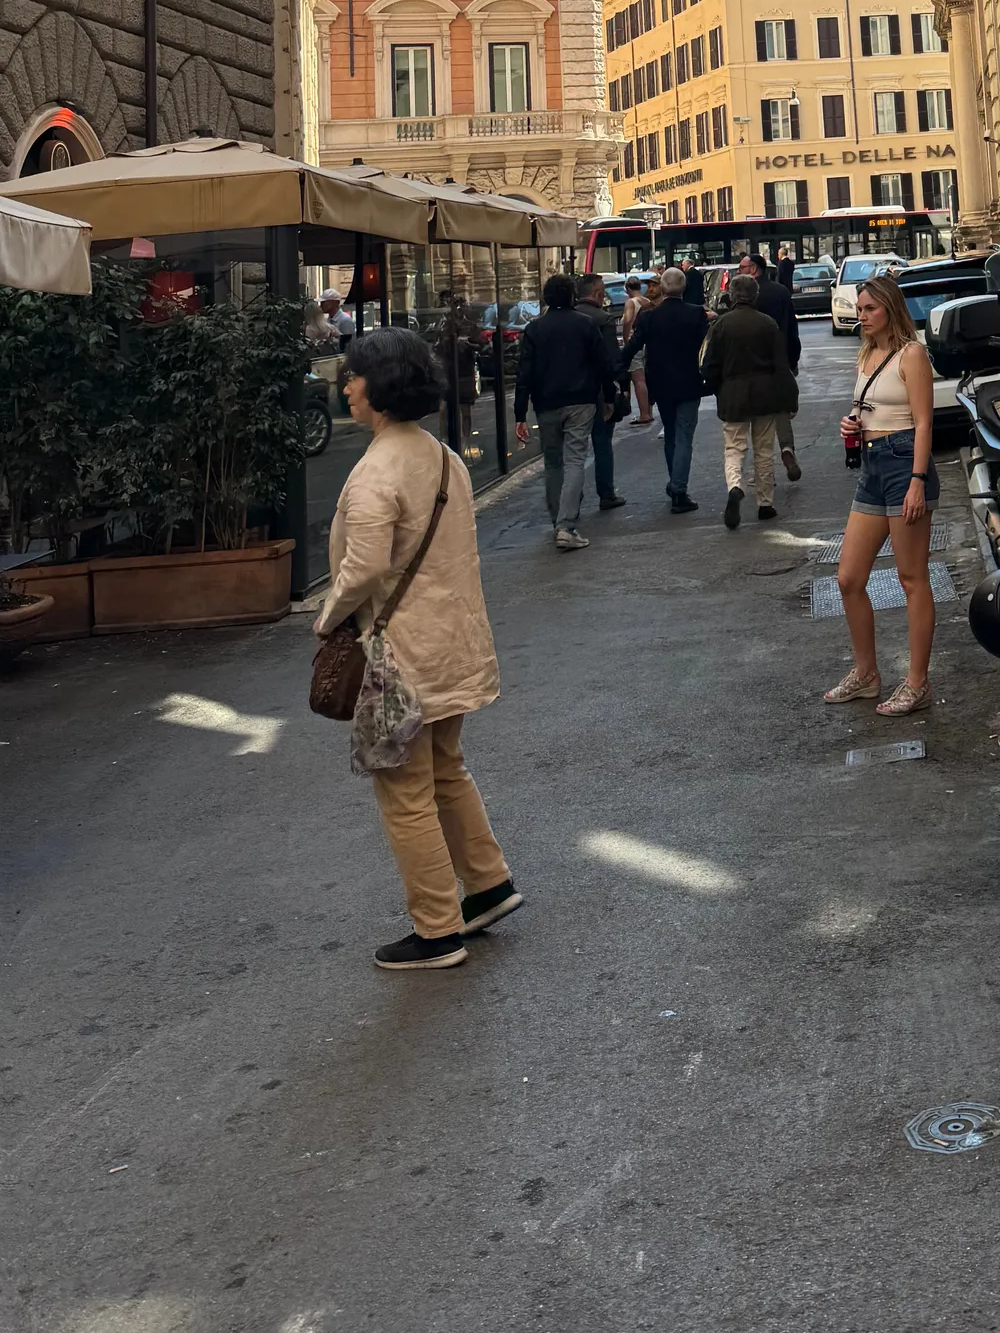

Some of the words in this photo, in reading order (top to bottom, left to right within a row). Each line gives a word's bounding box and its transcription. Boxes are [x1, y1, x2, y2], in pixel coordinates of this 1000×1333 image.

[755, 152, 833, 170] HOTEL
[842, 146, 917, 164] DELLE
[926, 144, 956, 158] NA
